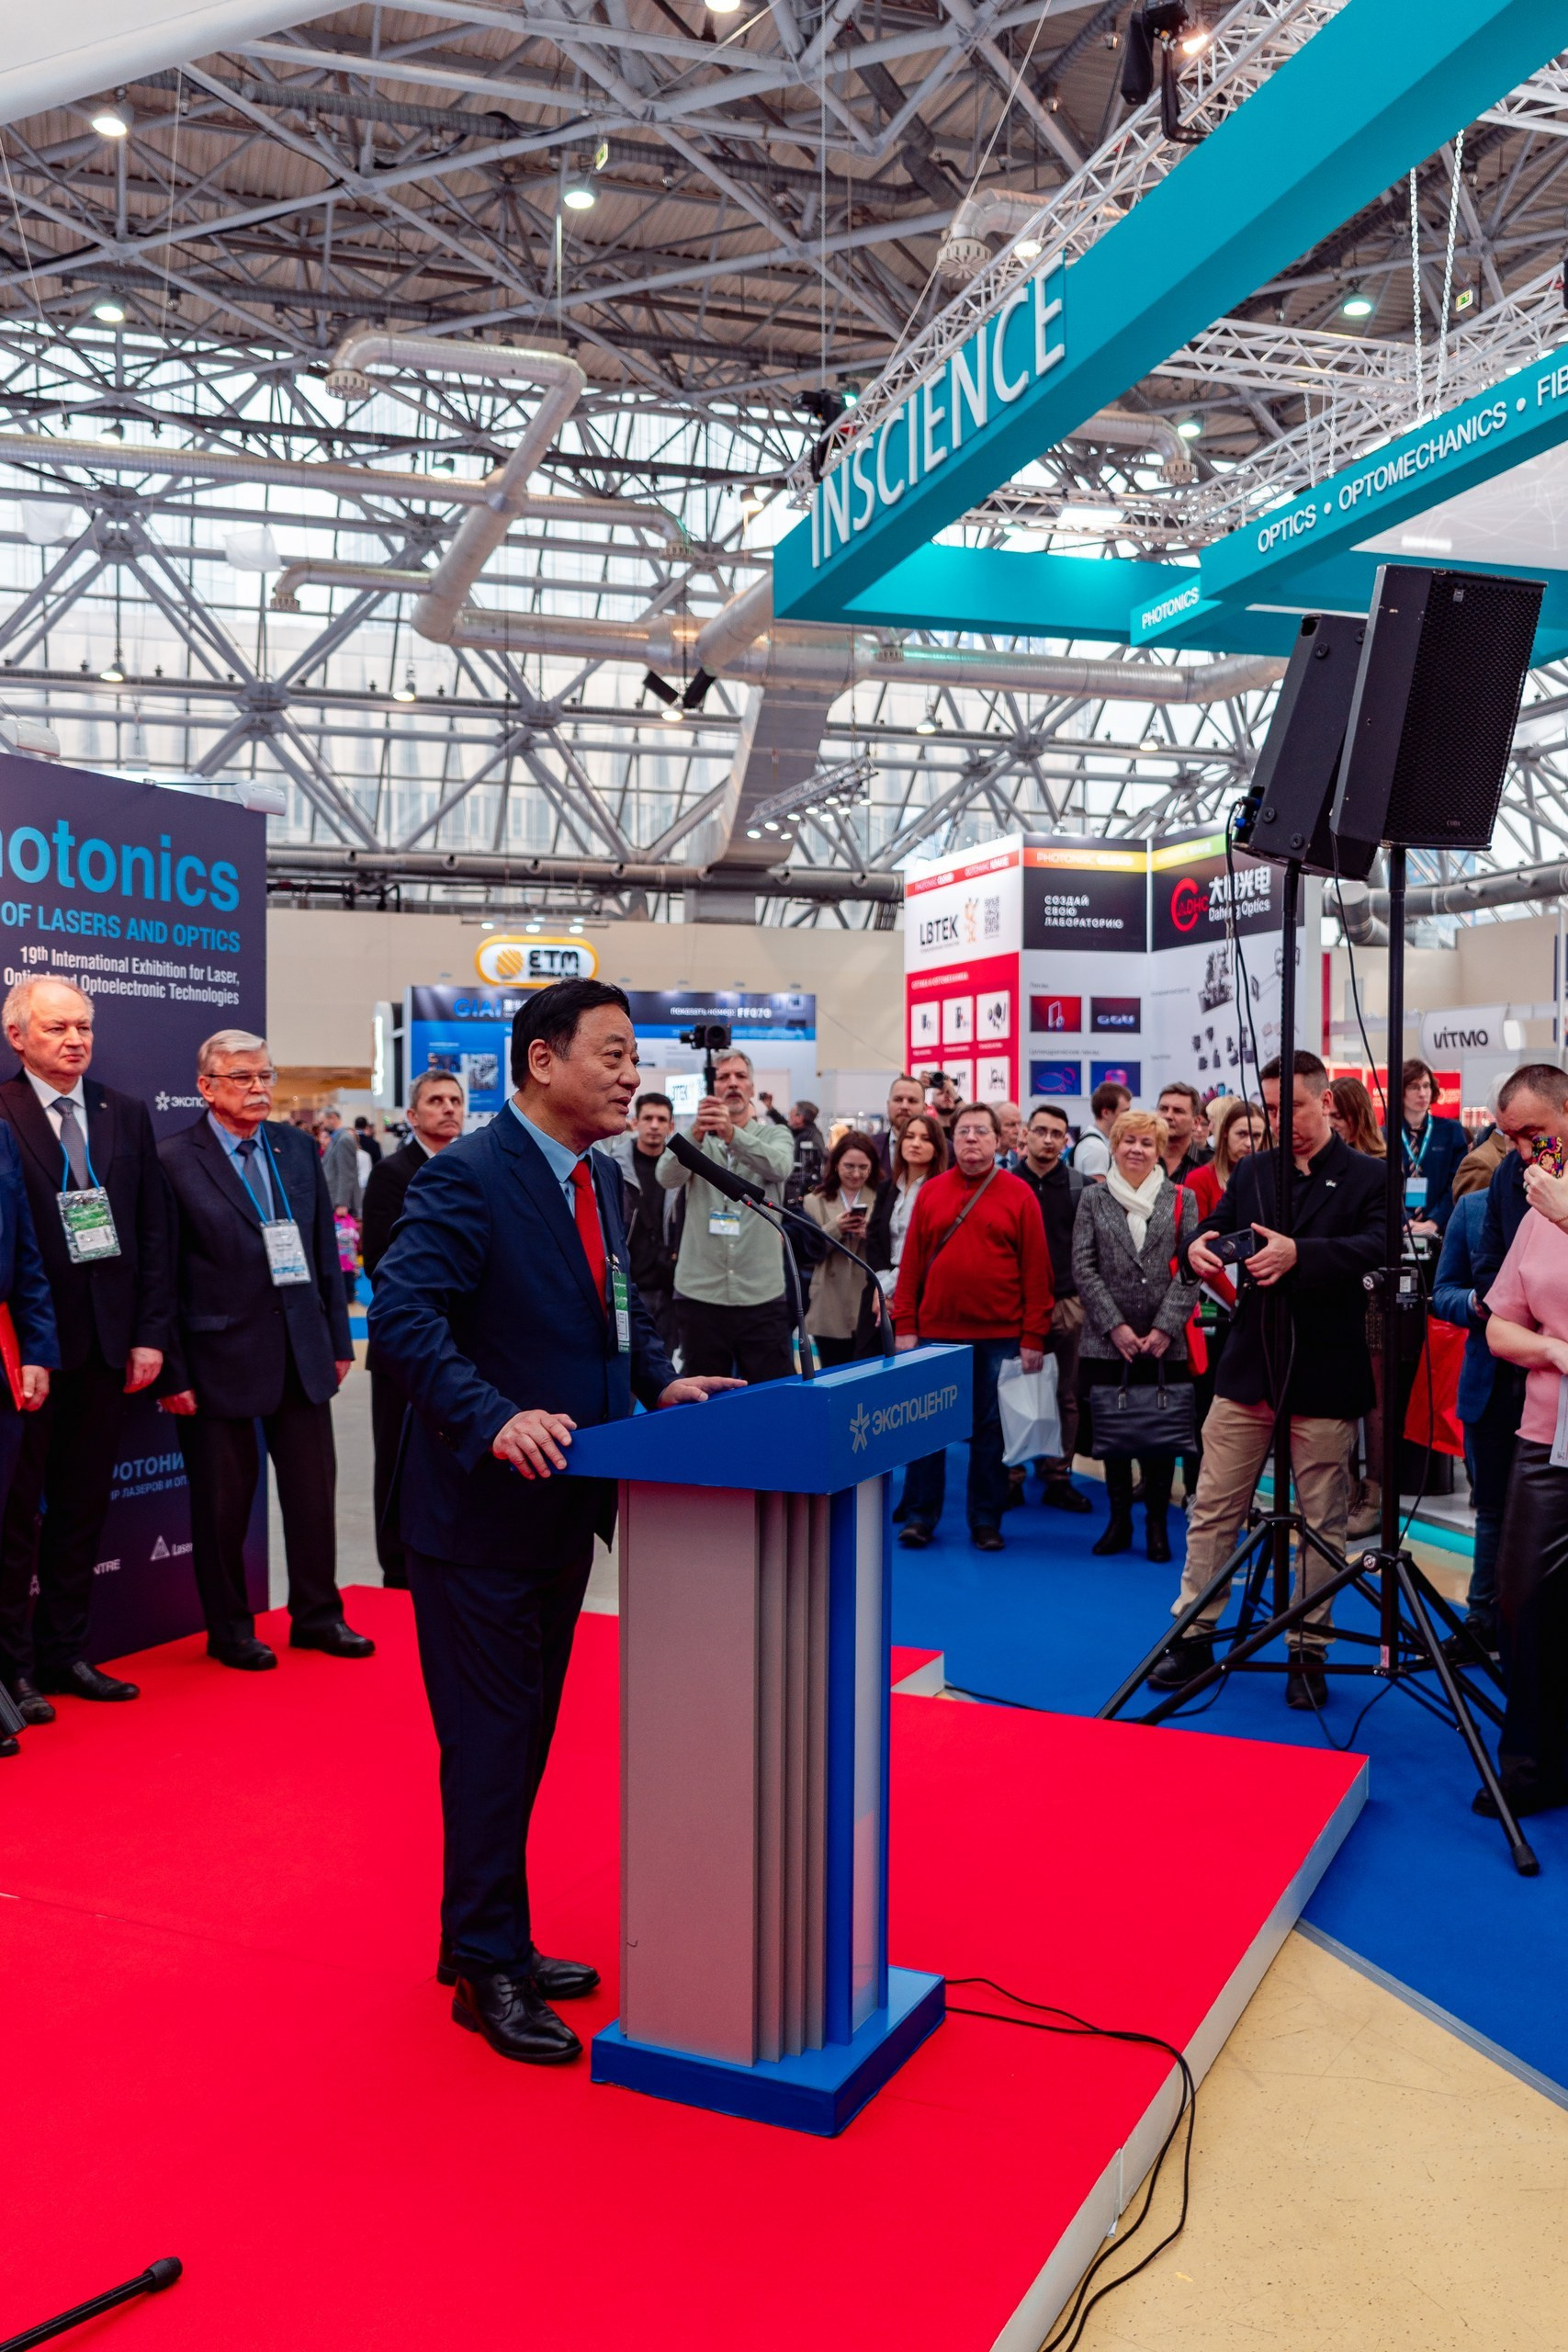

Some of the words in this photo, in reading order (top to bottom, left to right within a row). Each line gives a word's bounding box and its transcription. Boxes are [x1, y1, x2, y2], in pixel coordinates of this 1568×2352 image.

[812, 252, 1066, 568] INSCIENCE
[1258, 503, 1316, 553] OPTICS
[1338, 401, 1507, 511] OPTOMECHANICS
[1142, 586, 1200, 629] PHOTONICS
[0, 820, 240, 911] otonics
[1044, 895, 1089, 907] СОЗДАЙ
[1044, 906, 1077, 917] СВОЮ
[1242, 898, 1270, 918] Optics
[1, 901, 31, 927] OF
[38, 905, 121, 939] LASERS
[127, 918, 168, 944] AND
[173, 923, 241, 953] OPTICS
[919, 915, 958, 945] LBTEK
[1044, 917, 1123, 929] ЛАБОРАТОРИЮ
[20, 946, 48, 965] 19th
[51, 949, 129, 974] International
[132, 957, 186, 979] Exhibition
[189, 964, 205, 980] for
[208, 966, 240, 987] Laser,
[4, 967, 51, 988] Opti
[80, 974, 165, 997] Optoelectronic
[169, 982, 239, 1007] Technologies
[872, 1385, 958, 1435] ЭКСПОЦЕНТР
[122, 1480, 164, 1498] ЛАЗЕРОВ
